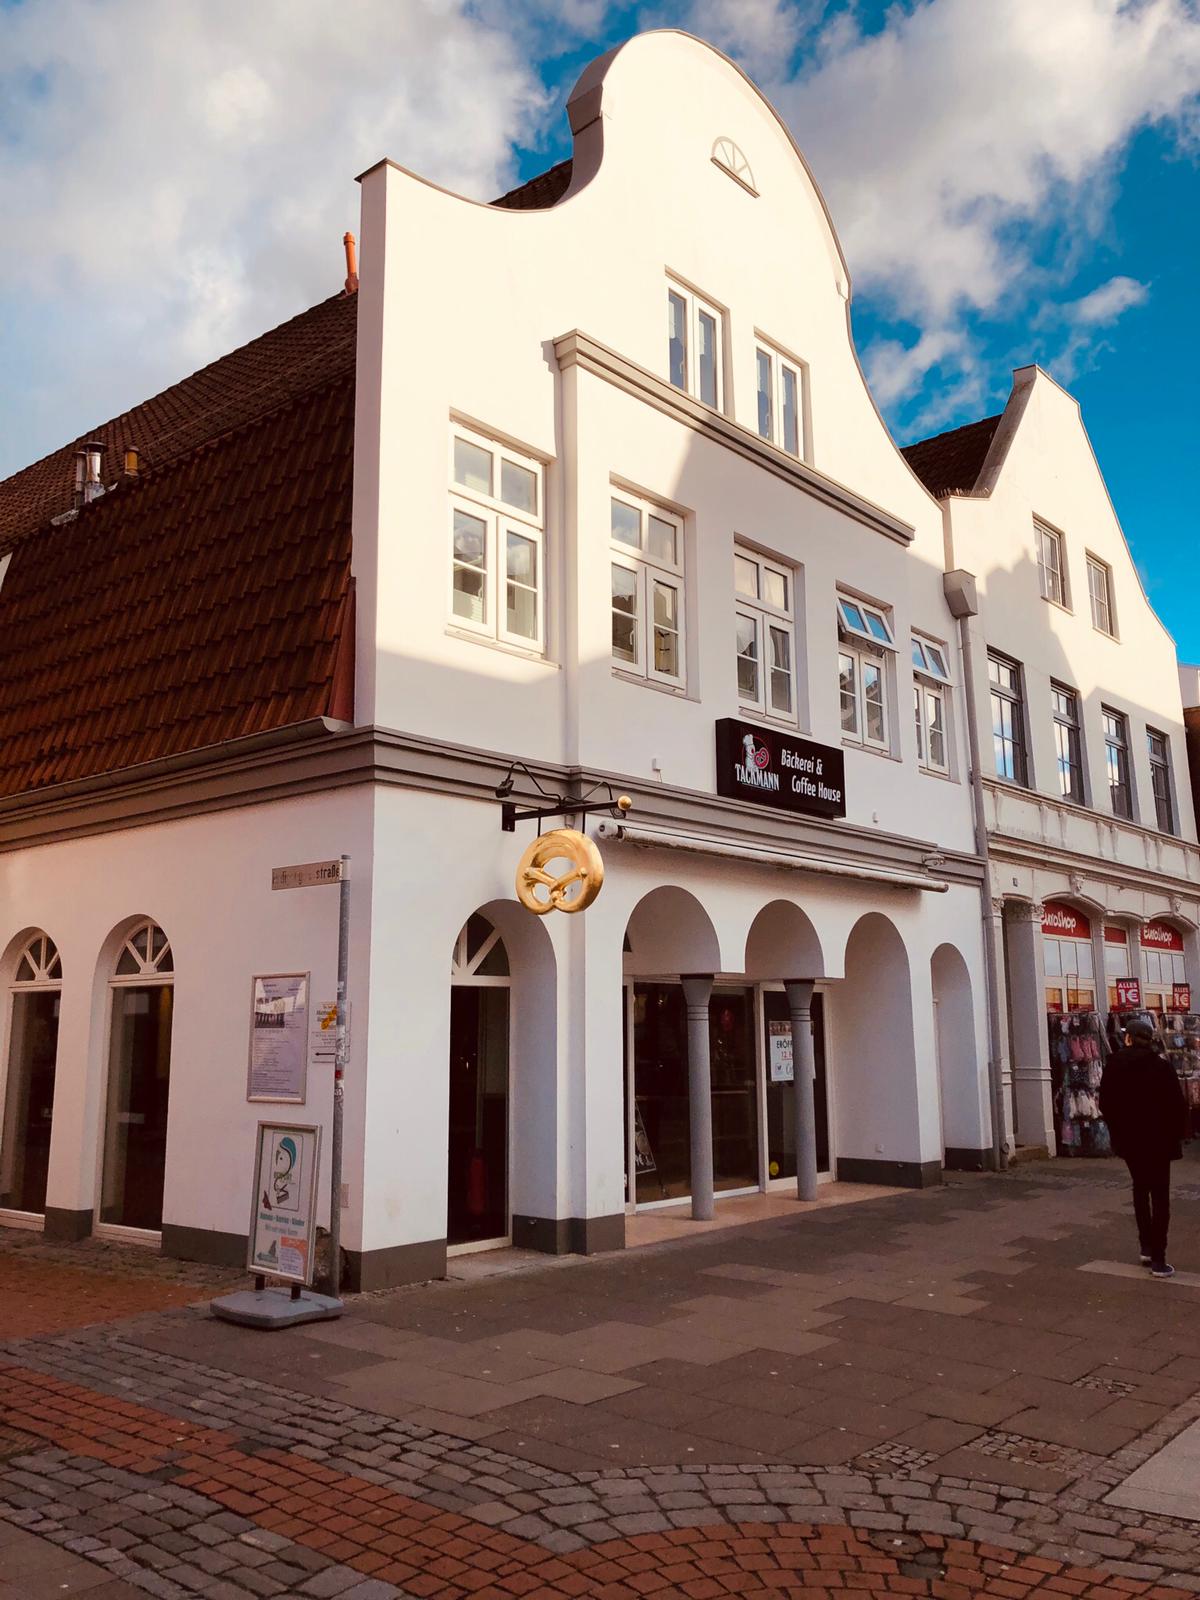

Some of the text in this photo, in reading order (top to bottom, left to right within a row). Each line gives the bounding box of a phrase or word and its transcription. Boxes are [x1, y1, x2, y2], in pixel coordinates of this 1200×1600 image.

[781, 748, 823, 775] Bäckerei &
[734, 763, 780, 791] TACKMANN
[791, 774, 841, 803] Coffee House
[1119, 989, 1139, 1004] 1€
